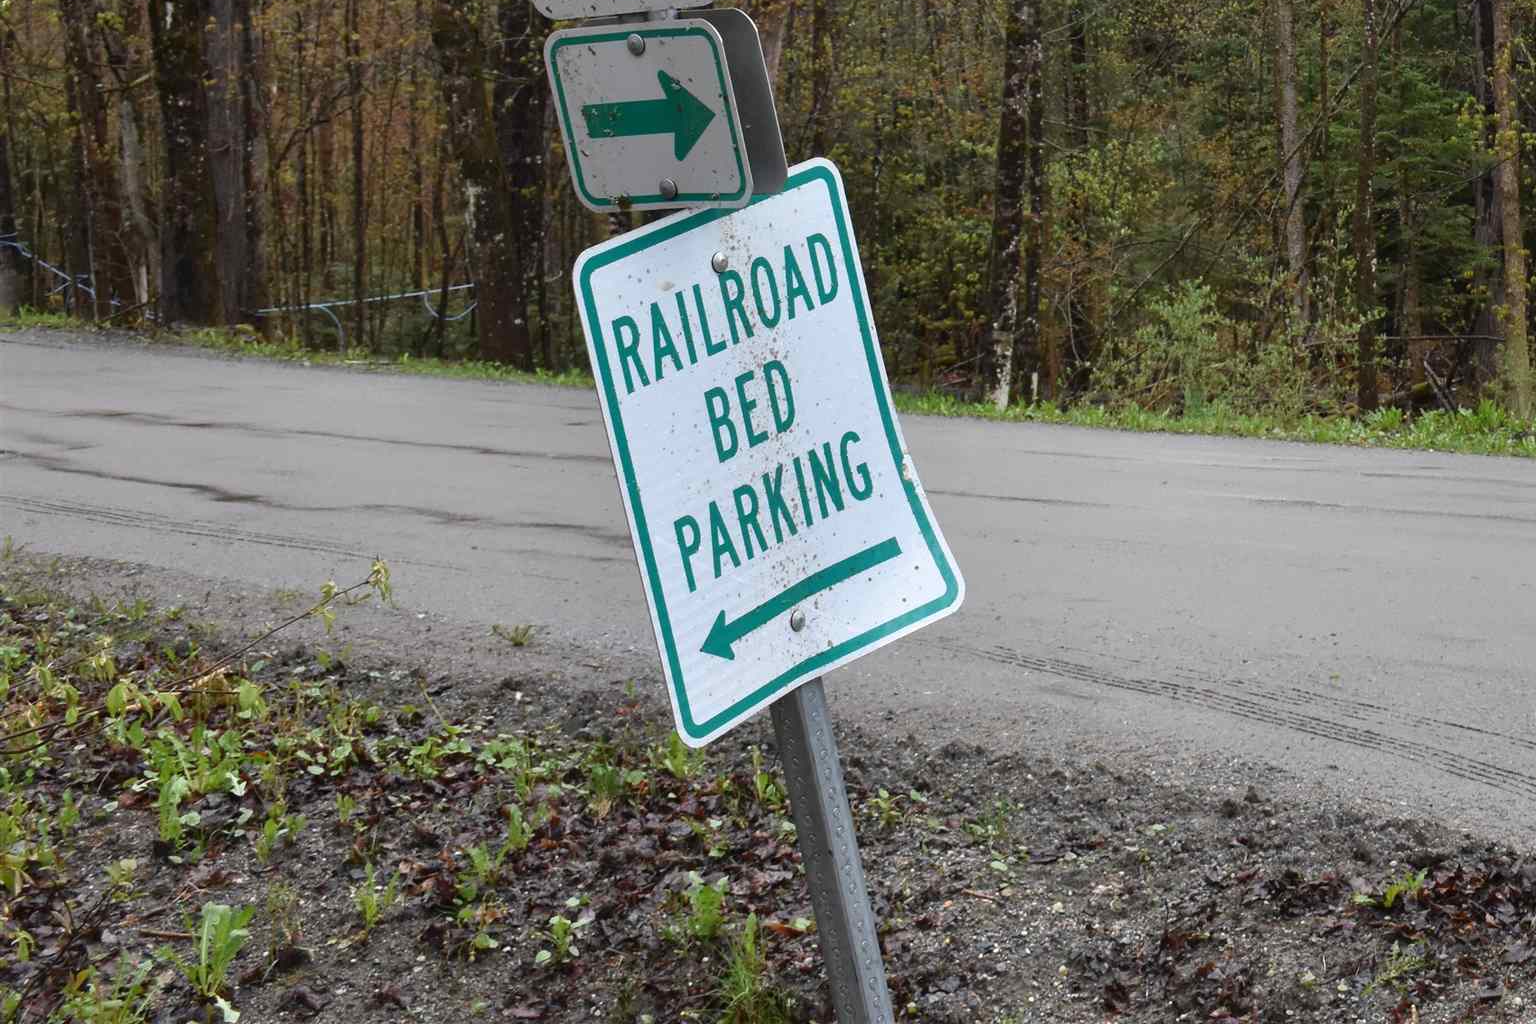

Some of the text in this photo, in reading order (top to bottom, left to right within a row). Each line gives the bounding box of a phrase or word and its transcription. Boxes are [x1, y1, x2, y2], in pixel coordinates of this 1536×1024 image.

[612, 232, 840, 395] RAILROAD
[703, 360, 797, 464] BED
[673, 431, 874, 594] PARKING
